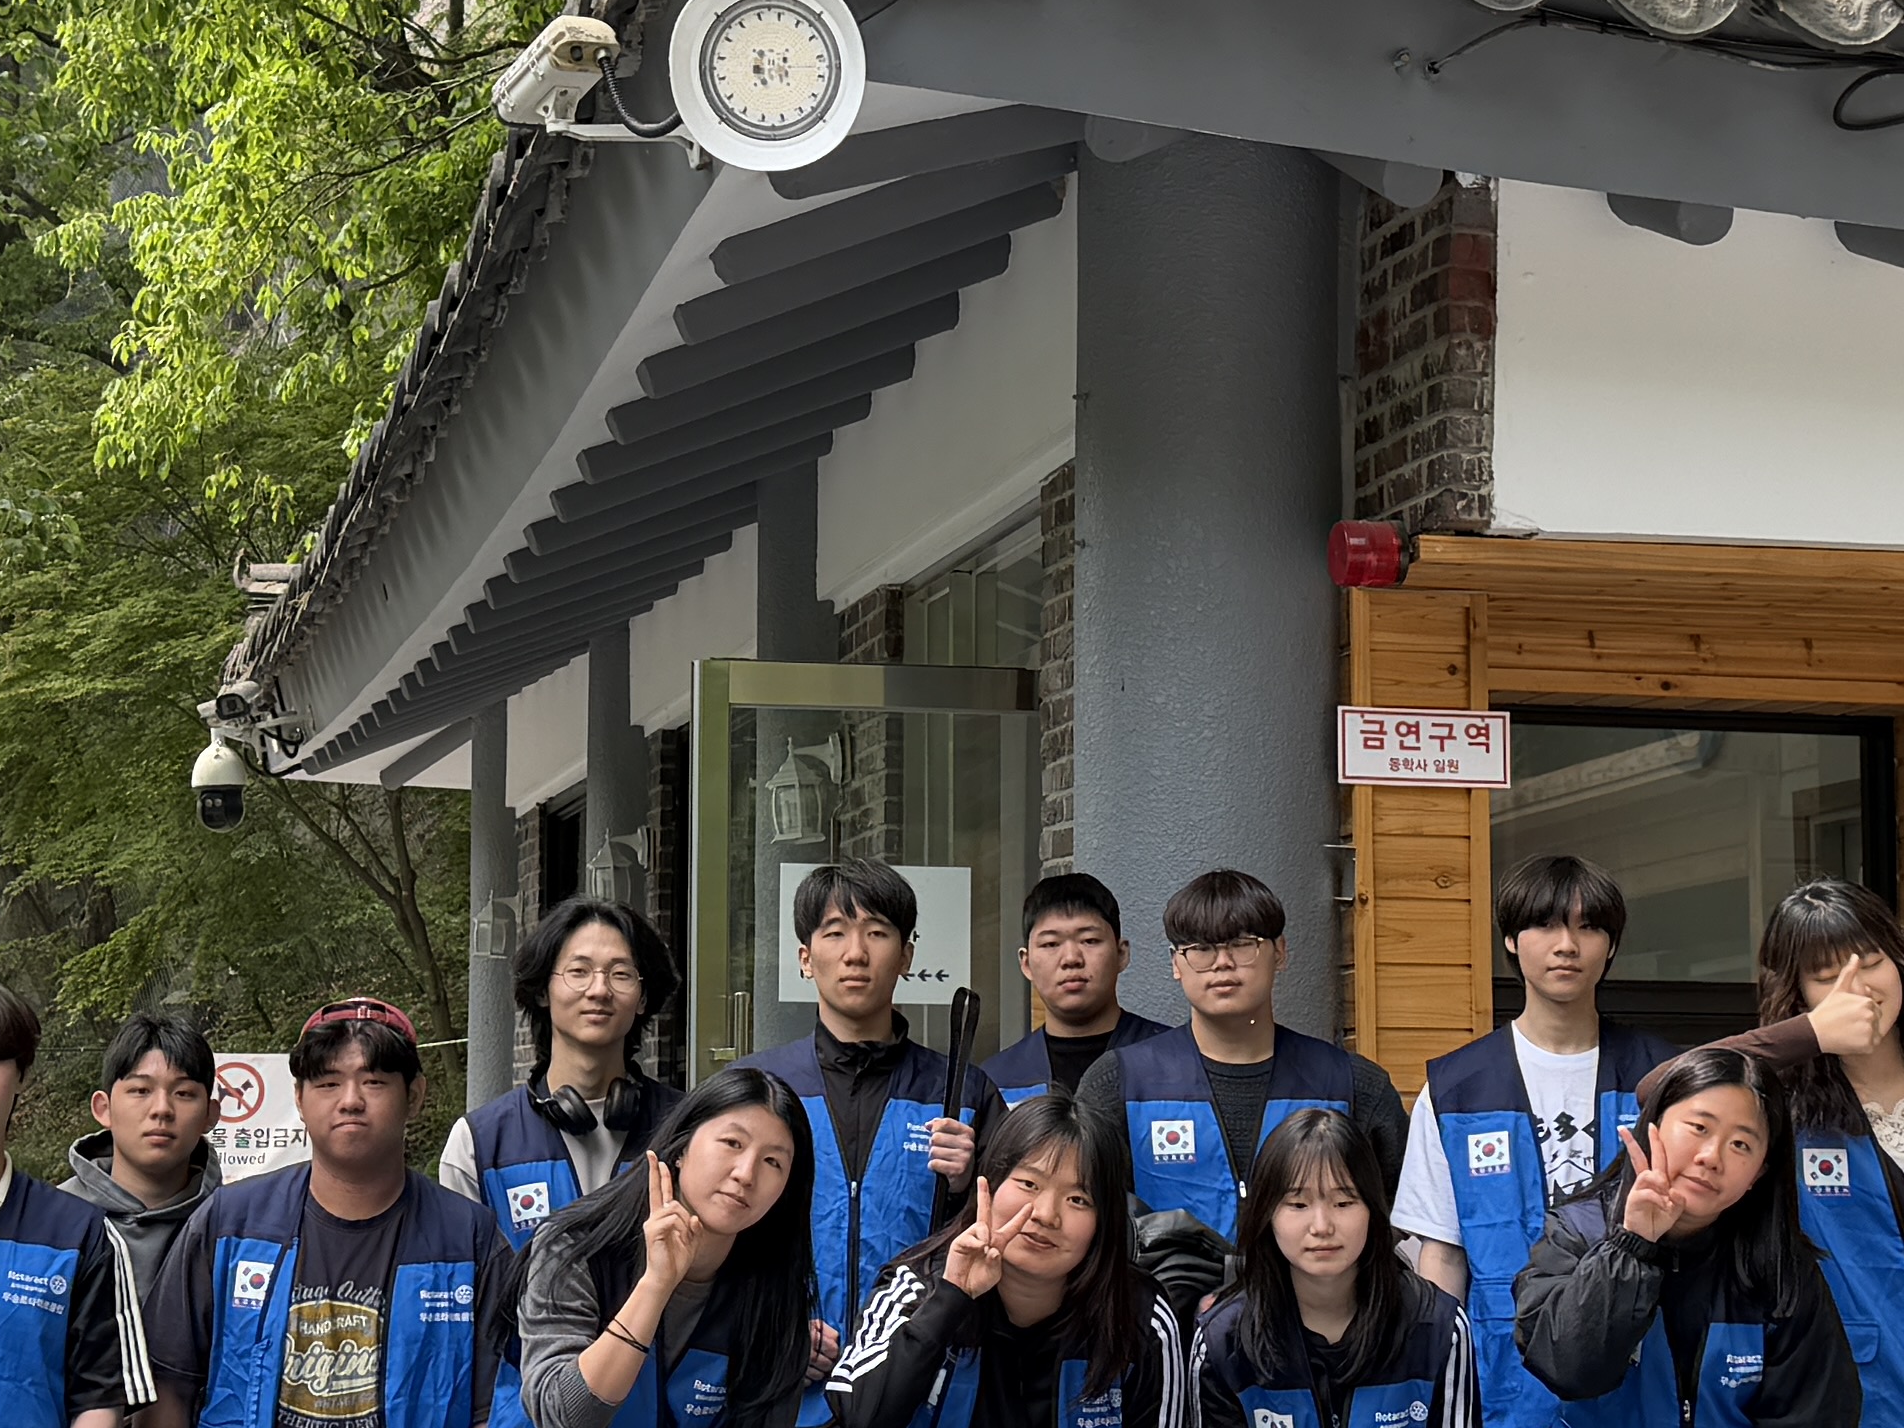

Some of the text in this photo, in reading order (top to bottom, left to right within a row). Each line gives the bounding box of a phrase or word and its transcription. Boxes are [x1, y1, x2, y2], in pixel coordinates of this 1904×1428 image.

[1360, 719, 1490, 753] 금연구역
[1388, 757, 1459, 773] 동학사 일원
[234, 1127, 308, 1149] 출입금지
